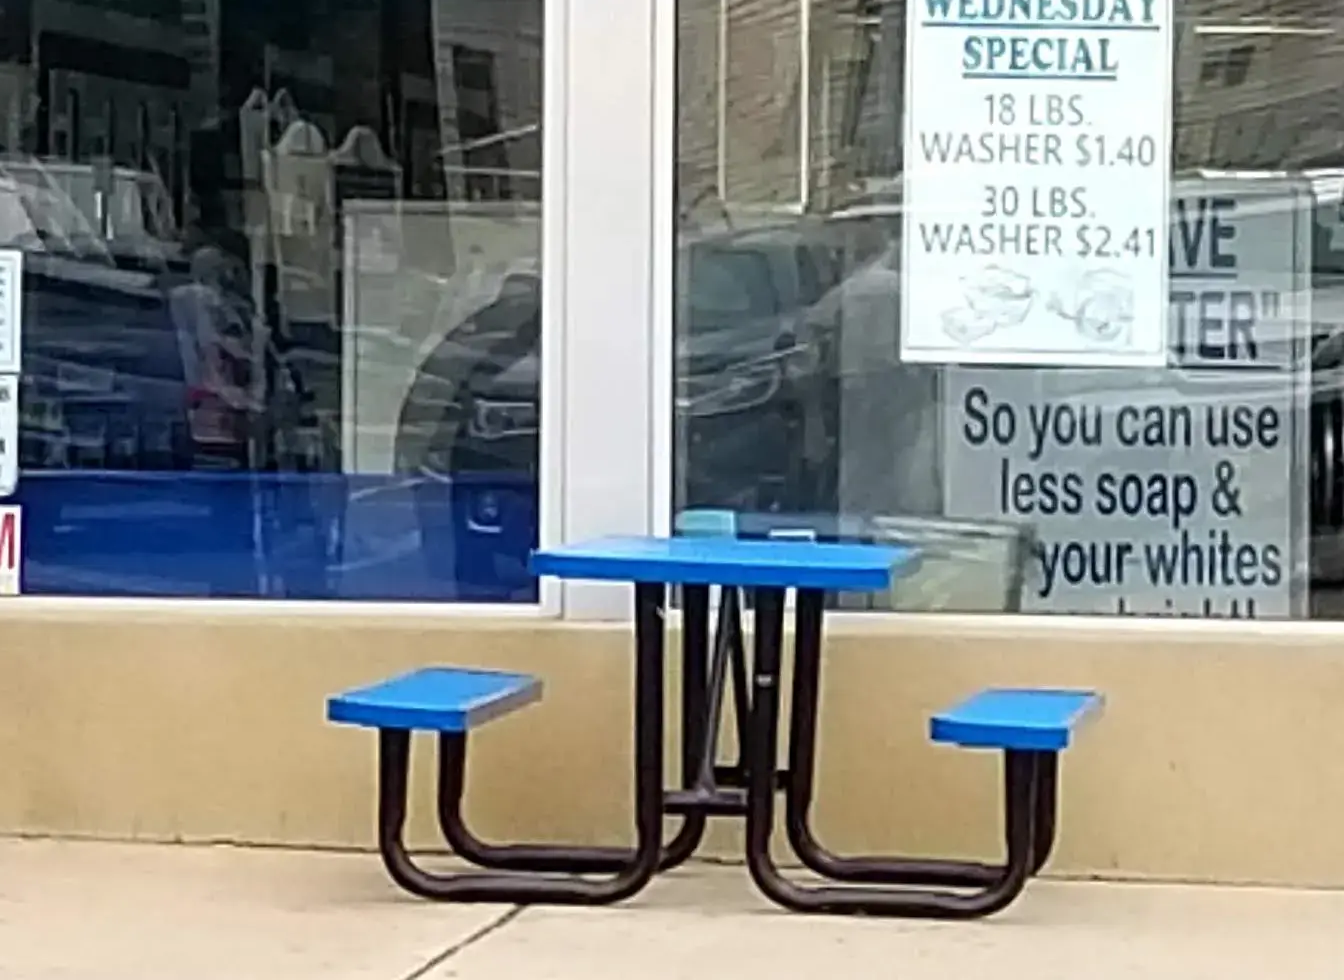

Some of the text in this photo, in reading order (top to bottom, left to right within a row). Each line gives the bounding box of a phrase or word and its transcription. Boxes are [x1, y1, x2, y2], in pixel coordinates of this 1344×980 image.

[962, 36, 1119, 73] SPECIAL
[983, 93, 1093, 126] 18 LBS.
[920, 132, 1156, 167] WASHER $1.40
[981, 186, 1096, 219] 30 LBS.
[920, 222, 1156, 259] WASHER $2.41
[963, 387, 1280, 460] So you can use
[1000, 458, 1243, 528] less soap &
[1037, 530, 1282, 599] your whites
